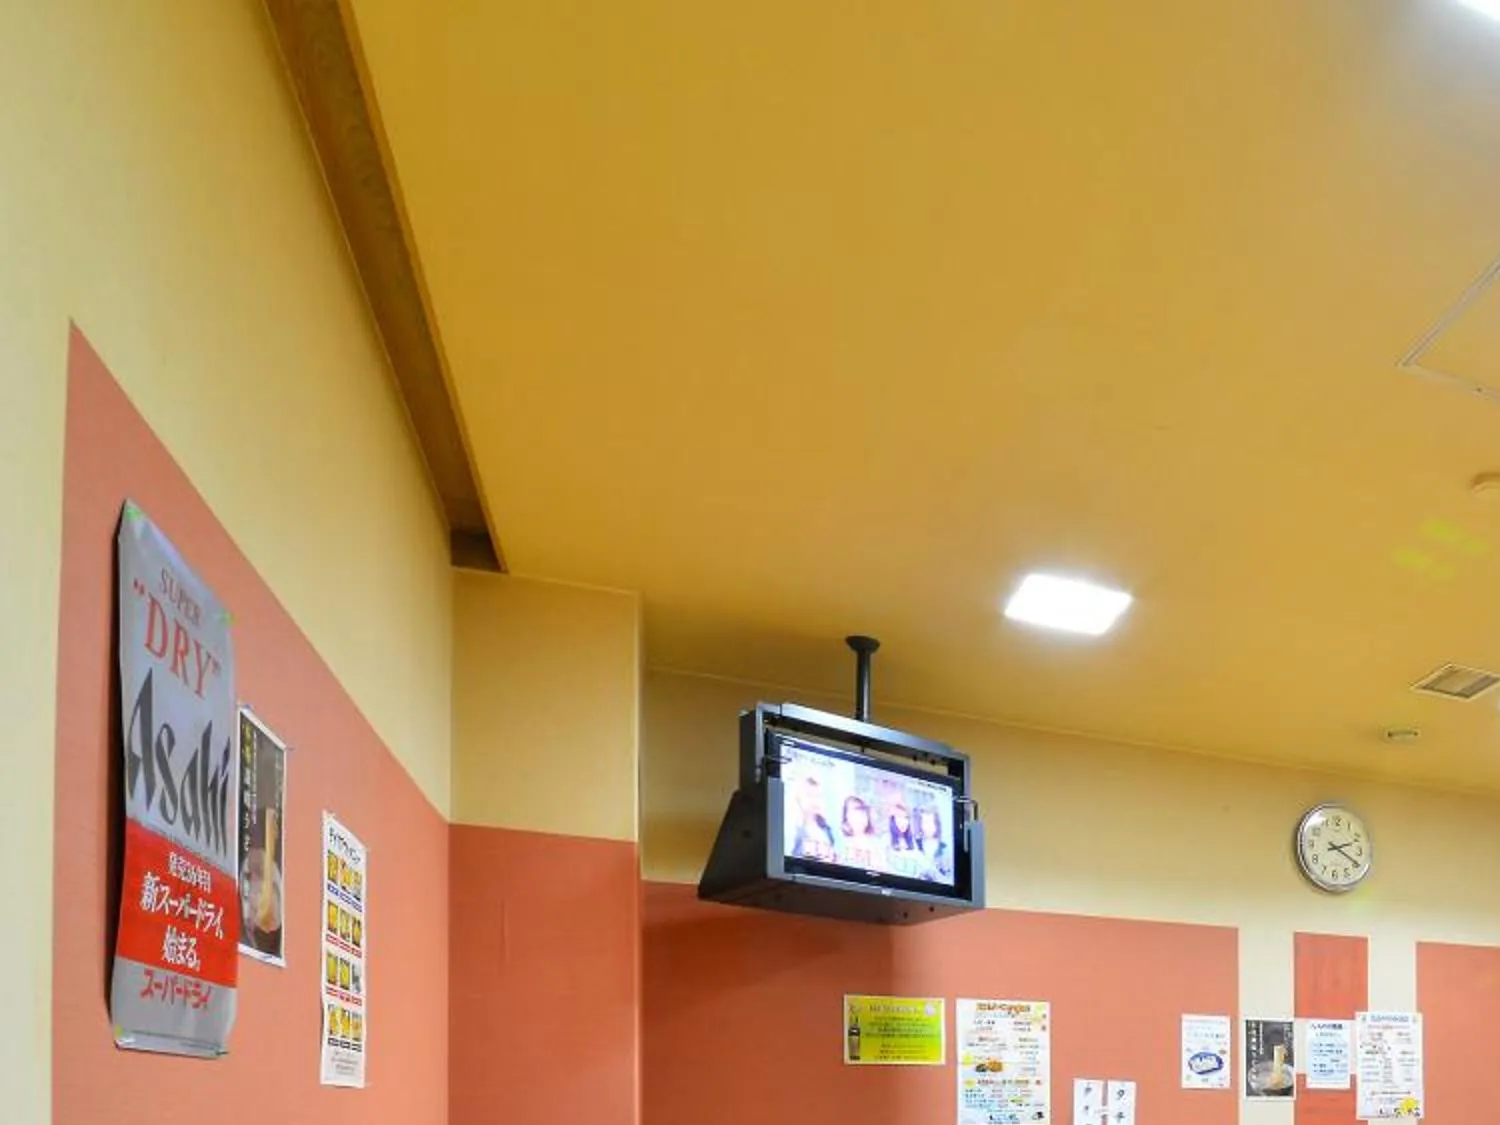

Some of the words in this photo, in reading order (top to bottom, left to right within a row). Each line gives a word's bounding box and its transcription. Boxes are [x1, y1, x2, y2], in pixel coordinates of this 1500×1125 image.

[160, 567, 201, 626] SUPER
[126, 667, 231, 857] Asahi
[140, 967, 213, 1010] スーパードライ
